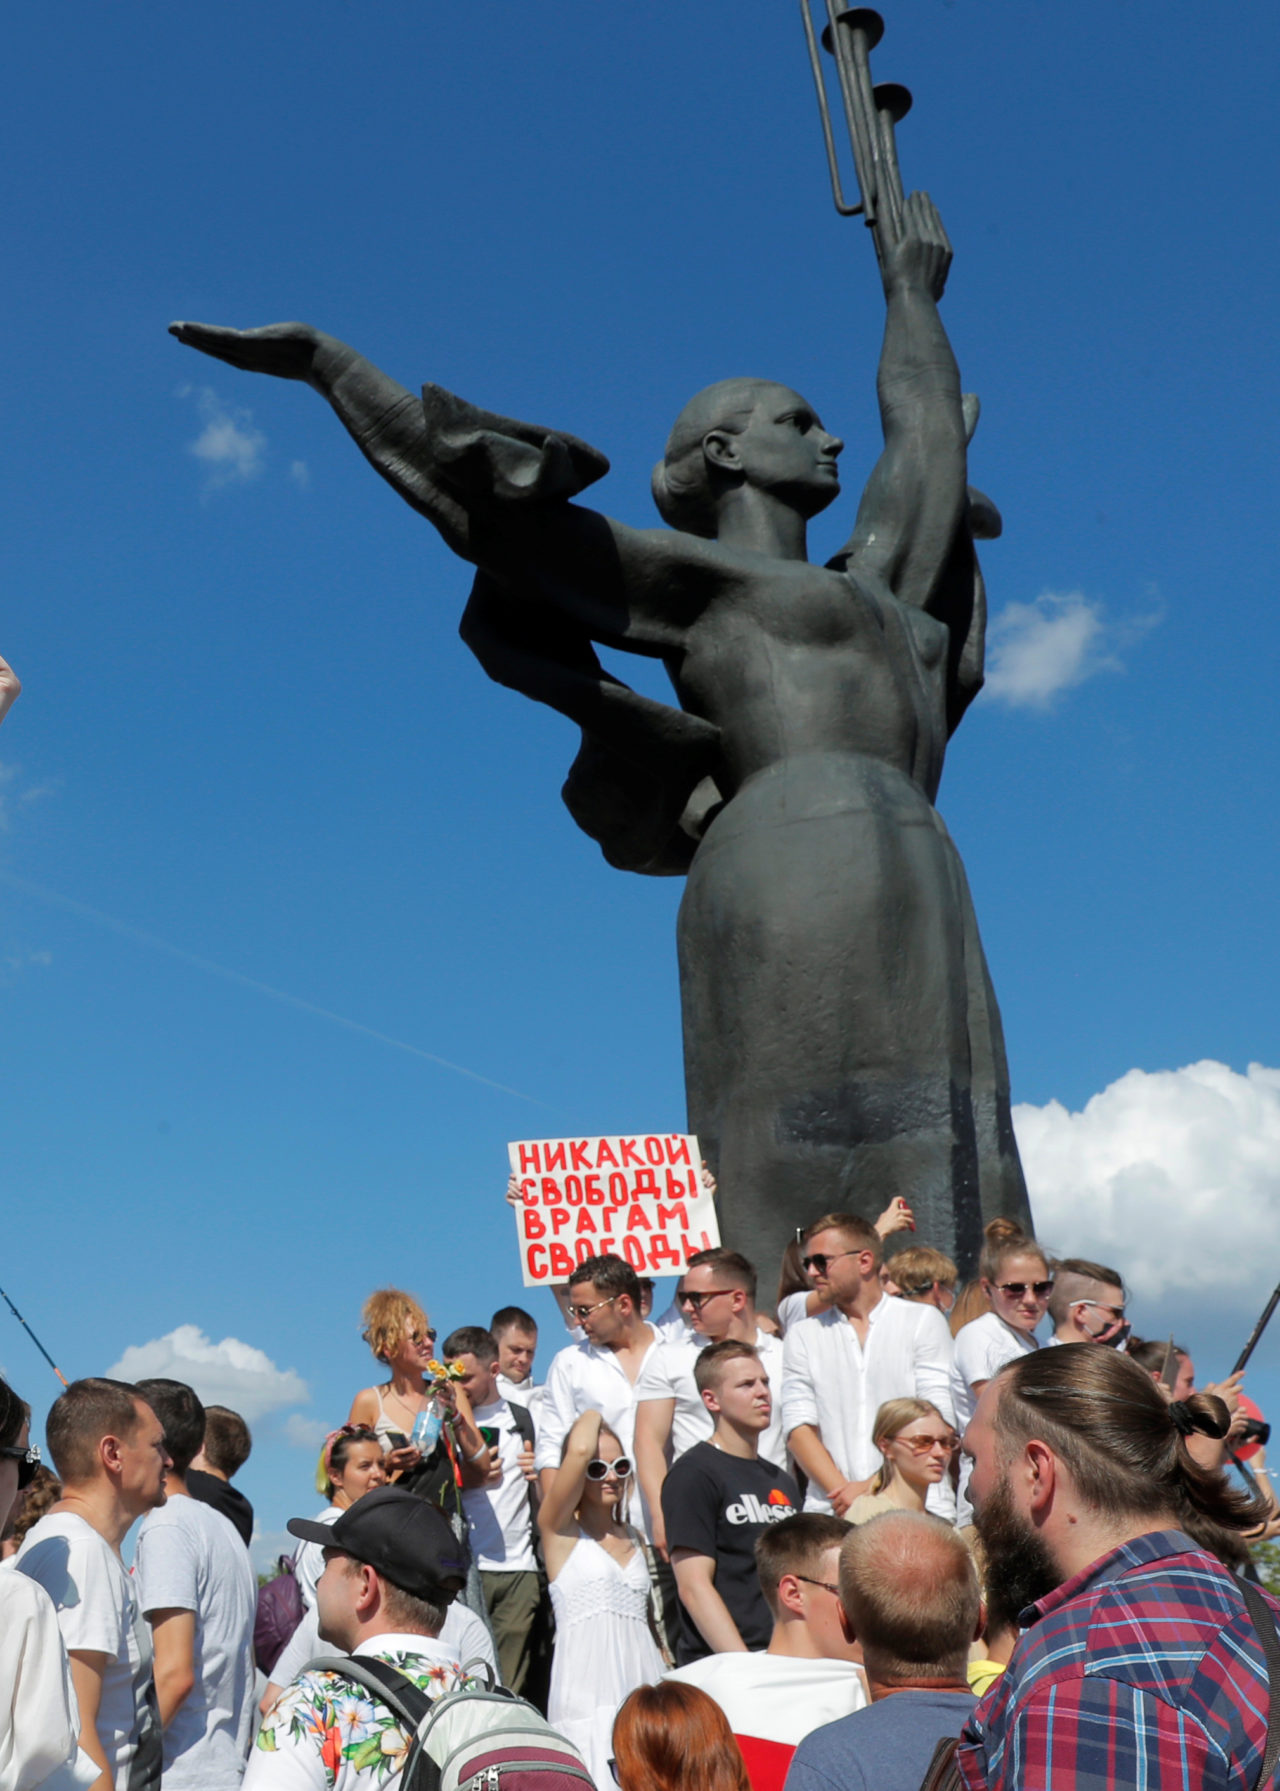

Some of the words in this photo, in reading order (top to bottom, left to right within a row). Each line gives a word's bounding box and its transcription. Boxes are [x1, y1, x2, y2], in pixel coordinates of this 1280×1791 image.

[518, 1134, 691, 1175] НИКАКОЙ
[521, 1168, 698, 1207] СВОБОДЫ
[523, 1202, 690, 1239] ВРАГАМ
[725, 1494, 797, 1526] elless
